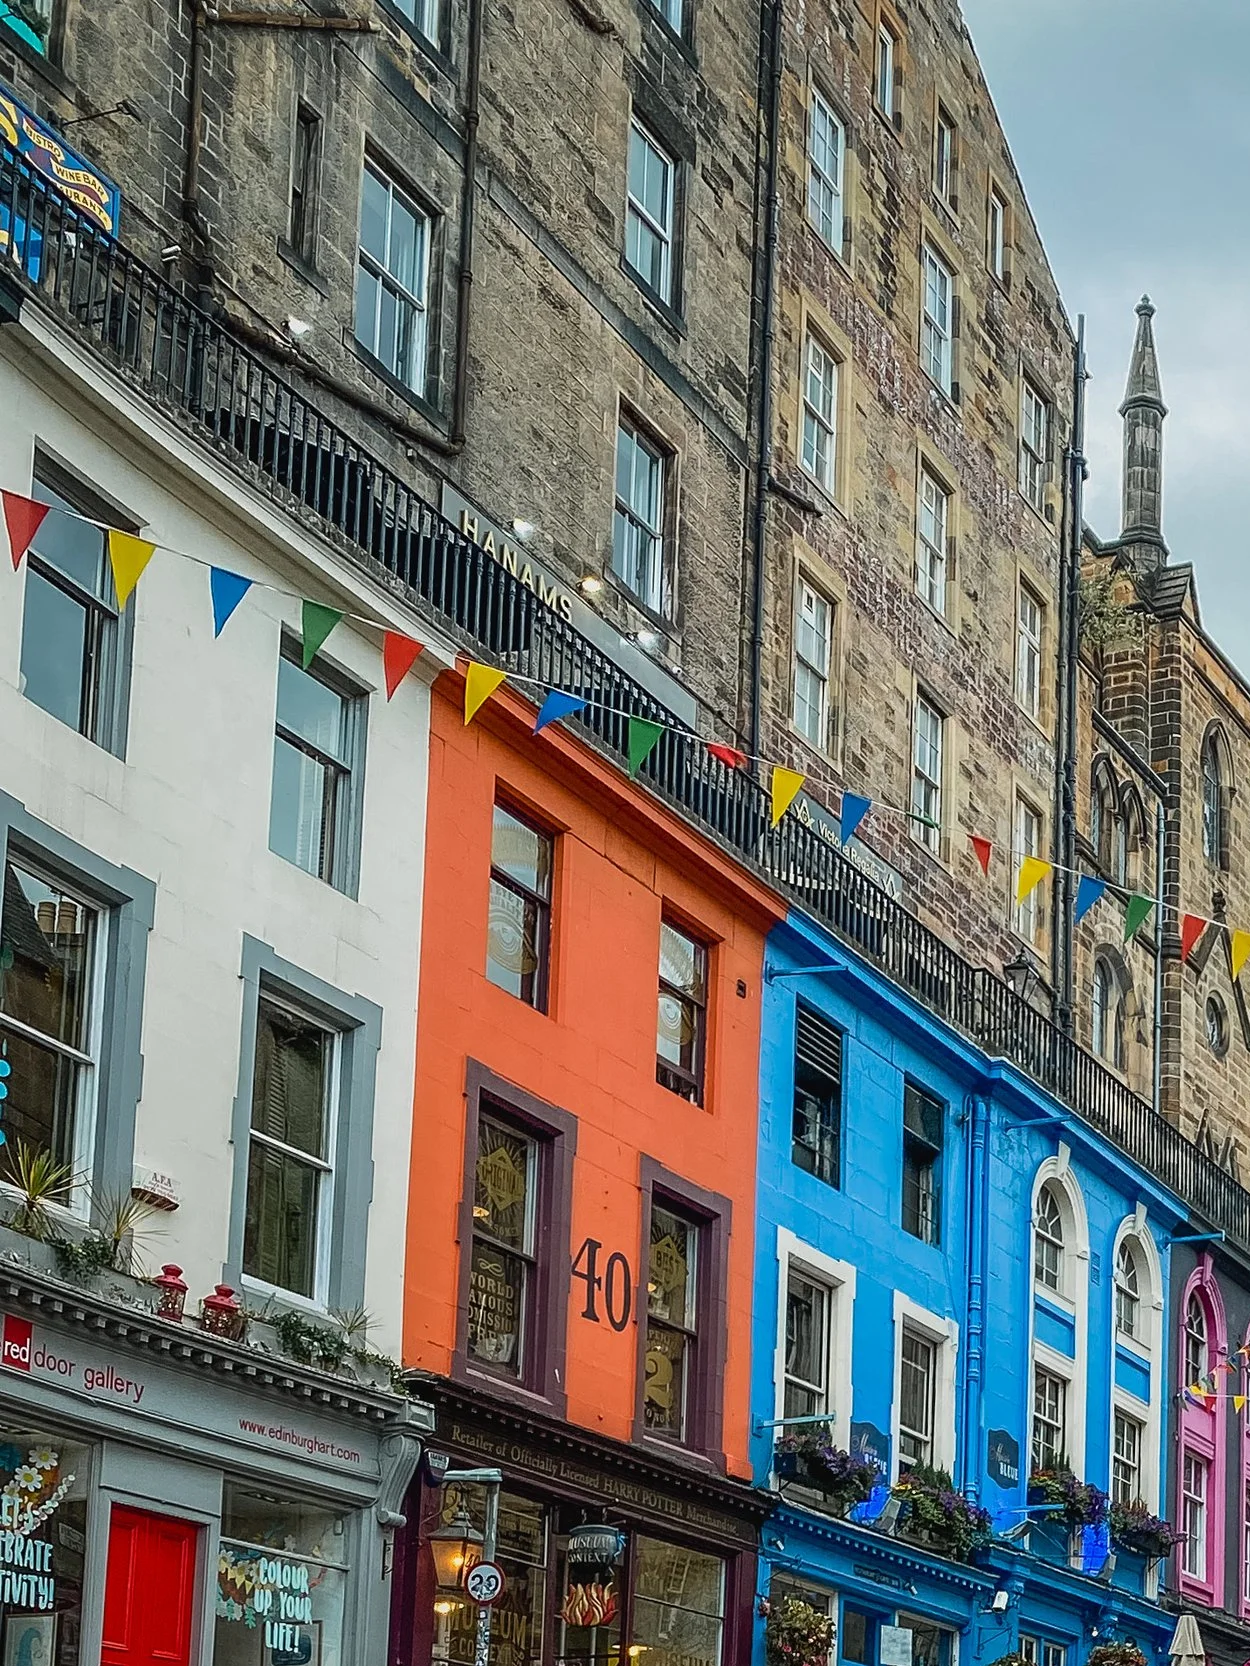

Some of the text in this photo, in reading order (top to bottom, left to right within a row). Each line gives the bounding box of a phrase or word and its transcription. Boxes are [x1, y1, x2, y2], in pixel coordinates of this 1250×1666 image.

[26, 125, 62, 159] BISTRO
[56, 163, 81, 183] WINE
[460, 509, 573, 623] HANAMS
[819, 819, 850, 857] Victoa
[571, 1237, 632, 1333] 40
[468, 1305, 512, 1333] DMISSIO
[469, 1291, 514, 1317] AMOUS
[4, 1338, 144, 1403] red door gallery
[239, 1418, 360, 1463] www.edinburghart.com
[451, 1424, 494, 1452] Retailer
[495, 1442, 507, 1457] of
[510, 1445, 558, 1477] Officially
[560, 1462, 599, 1488] Licensed
[603, 1478, 641, 1503] HARRY
[642, 1490, 683, 1517] POTTER
[259, 1557, 309, 1594] COLOUR
[471, 1573, 499, 1592] 20
[254, 1589, 313, 1625] UP YOUR
[265, 1620, 300, 1653] LIFE!
[446, 1606, 527, 1650] MUEUM
